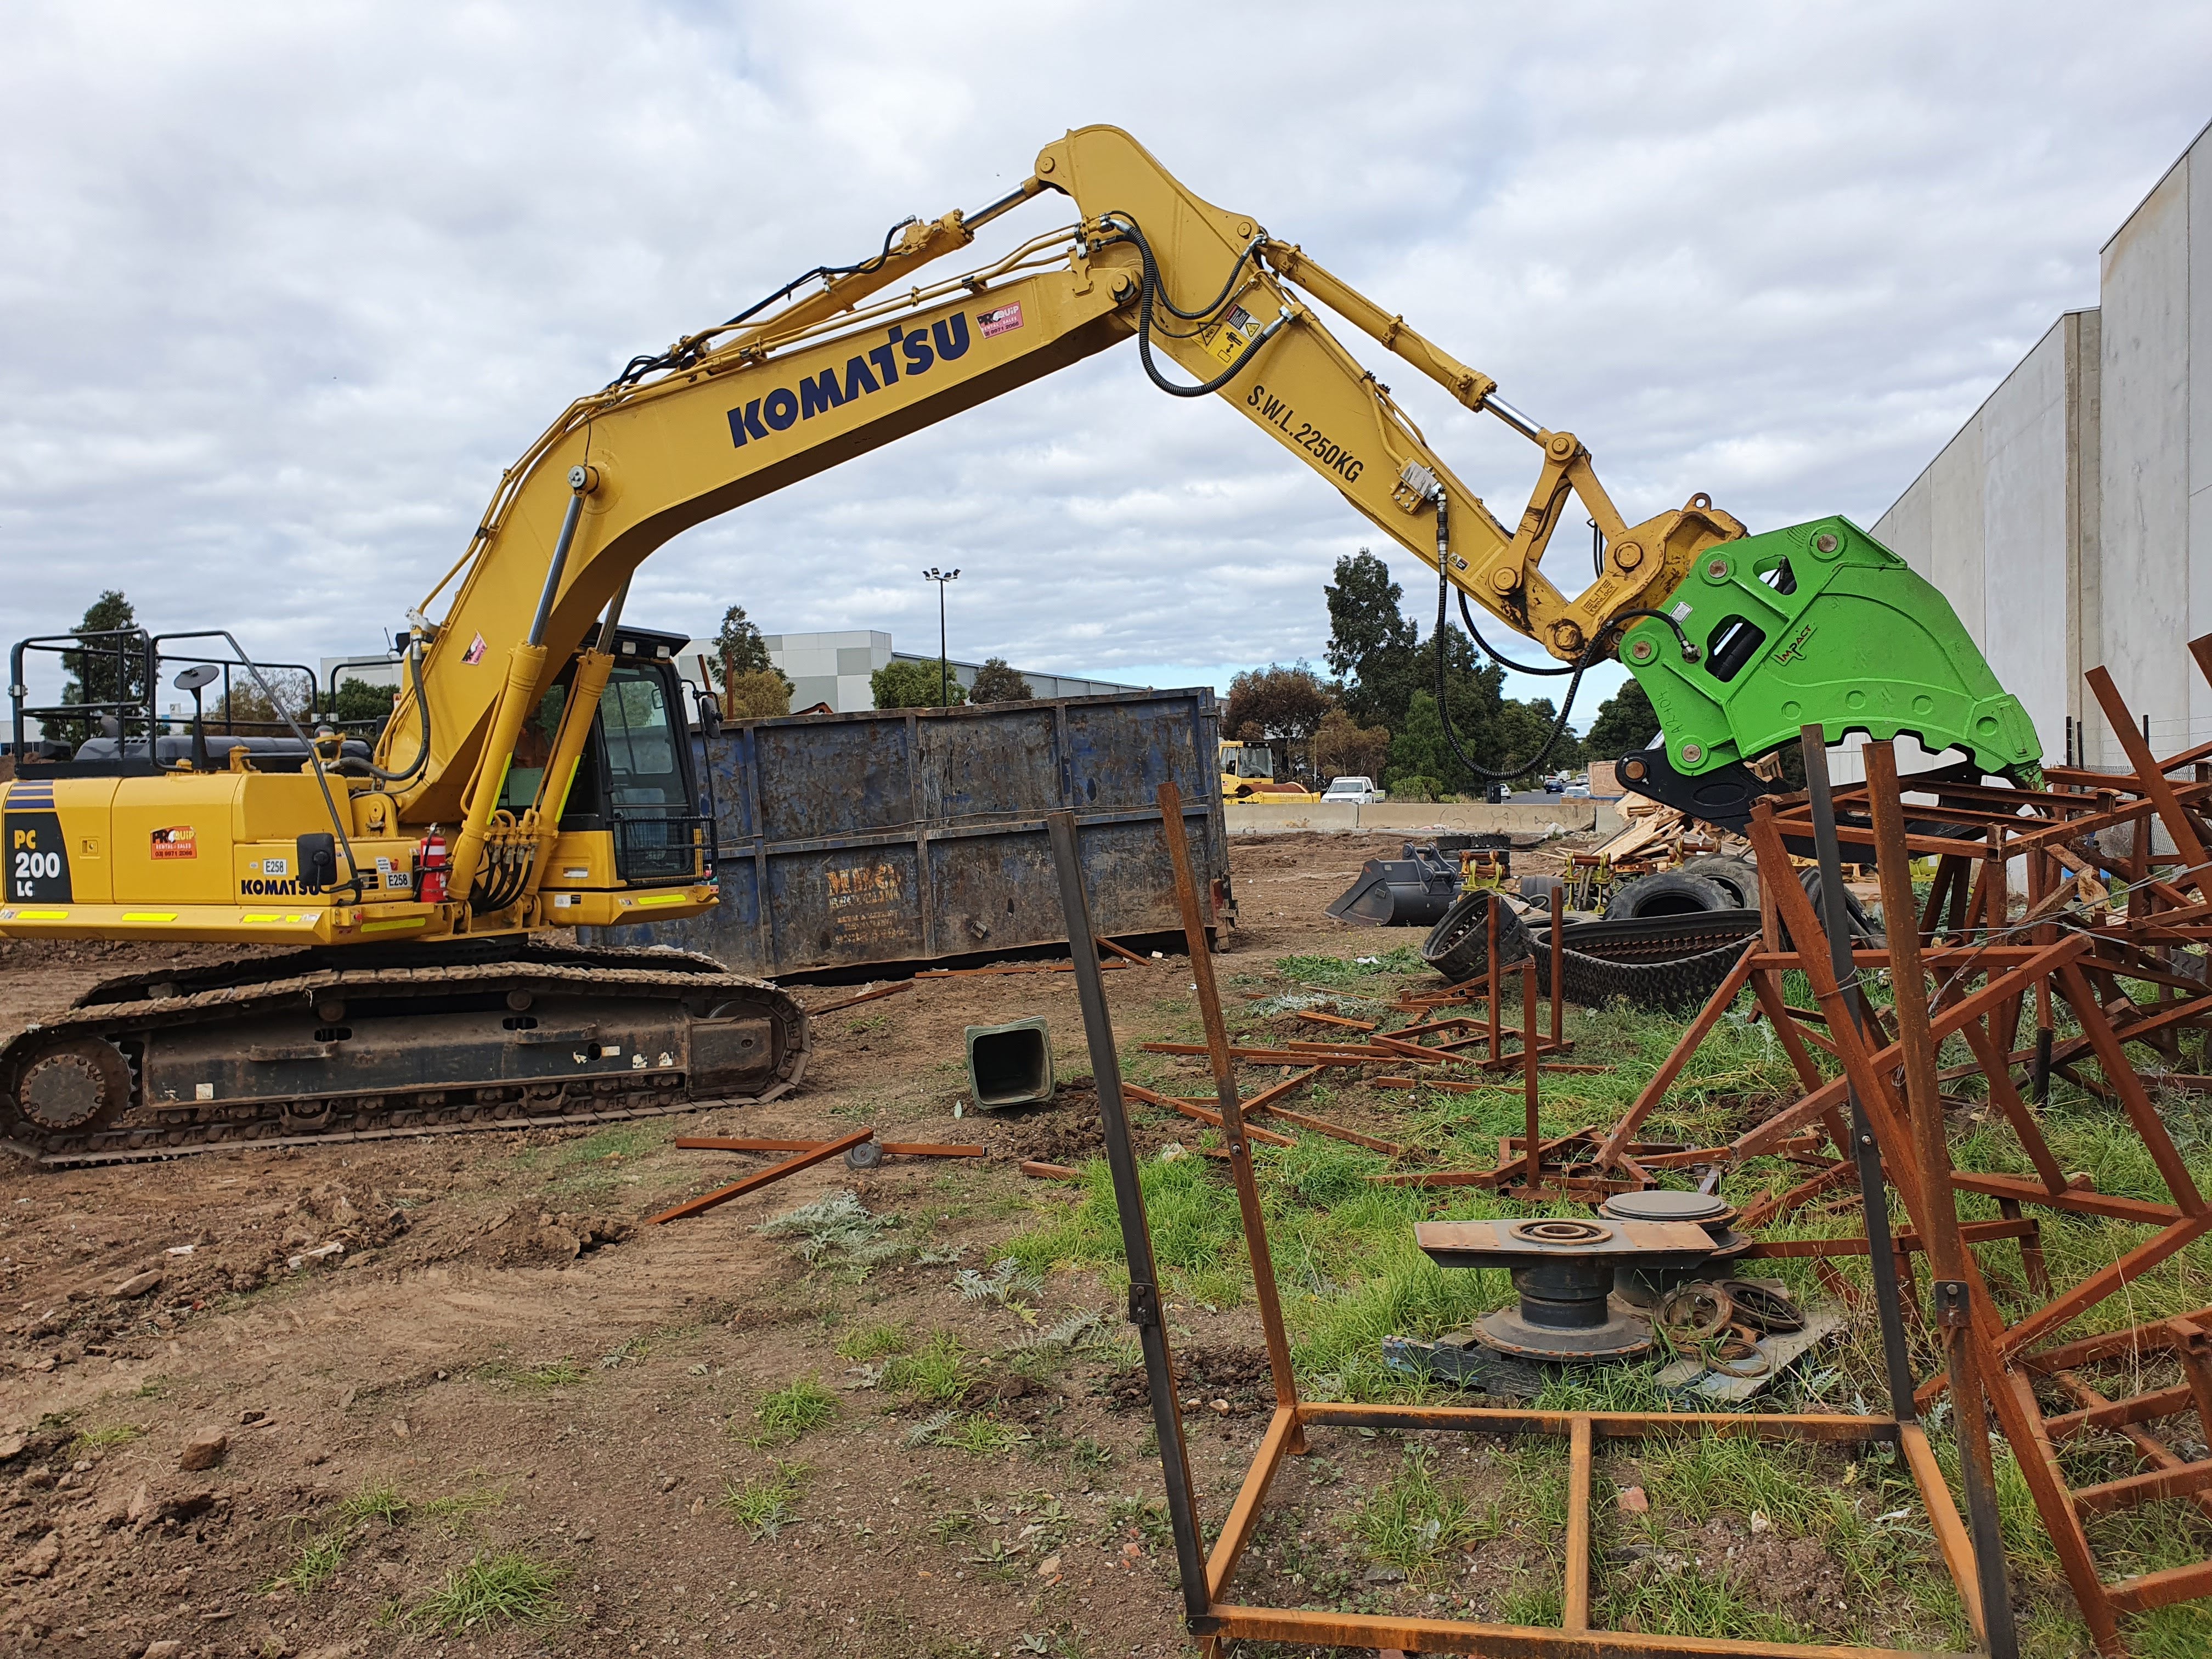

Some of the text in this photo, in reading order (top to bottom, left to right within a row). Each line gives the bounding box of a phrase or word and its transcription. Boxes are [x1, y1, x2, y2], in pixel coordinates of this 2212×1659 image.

[1002, 316, 1017, 325] SALES
[727, 311, 970, 448] KOMATSU
[1247, 385, 1364, 483] S.W.L.2250KG
[1583, 579, 1611, 609] ELITE
[1589, 585, 1616, 614] TWINLOCK
[14, 829, 36, 850] PC
[15, 851, 60, 878] 200
[266, 861, 284, 873] E258
[16, 880, 33, 897] LC
[388, 873, 408, 887] E258
